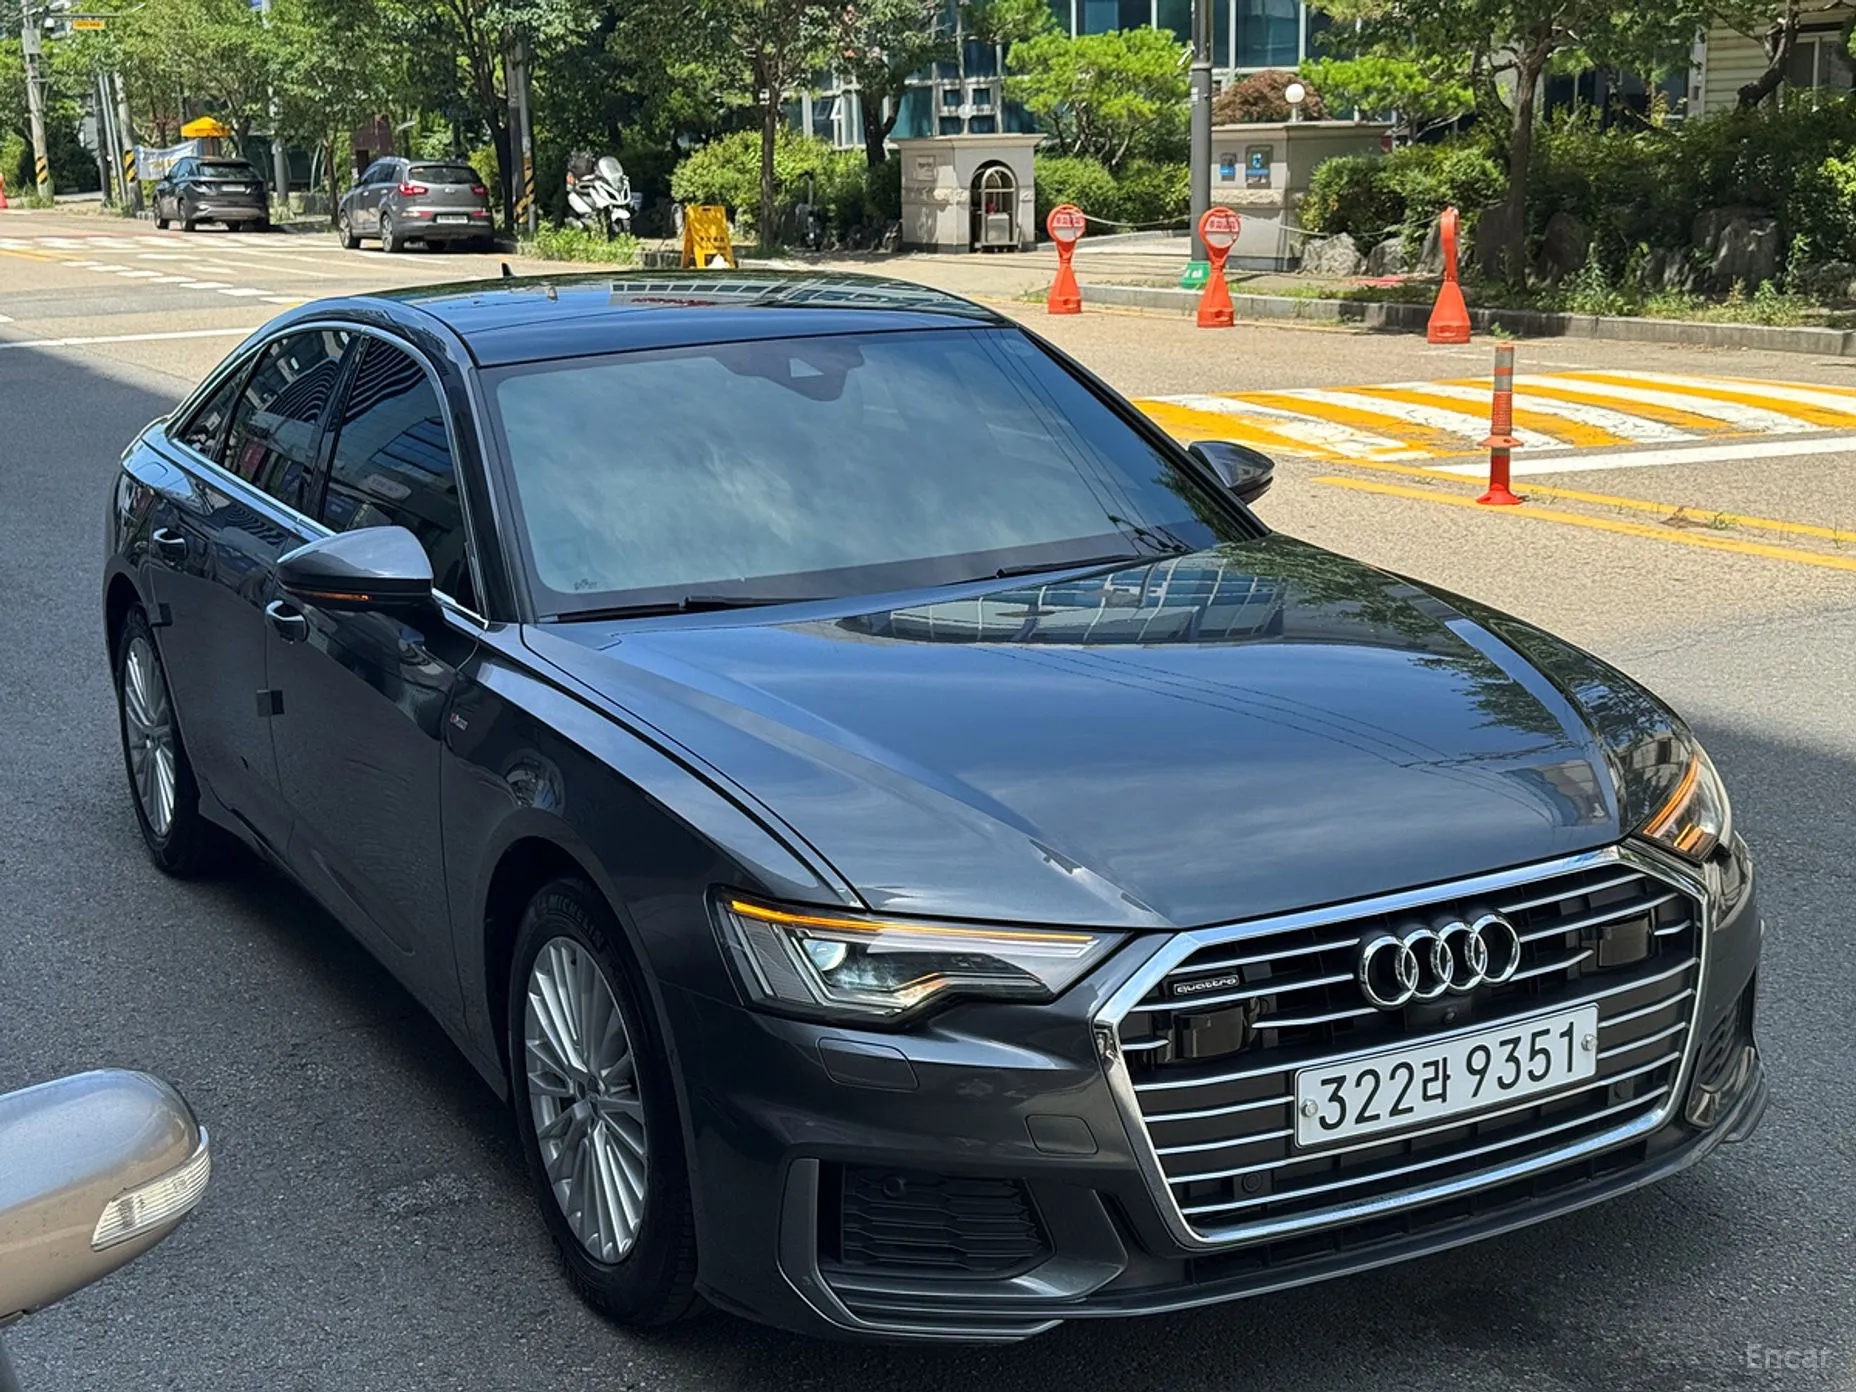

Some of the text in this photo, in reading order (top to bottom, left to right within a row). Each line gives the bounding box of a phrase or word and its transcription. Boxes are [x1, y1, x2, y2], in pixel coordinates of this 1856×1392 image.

[548, 894, 606, 949] MICHELIN
[1176, 977, 1237, 993] quattro
[1318, 1021, 1575, 1131] 322라 9351
